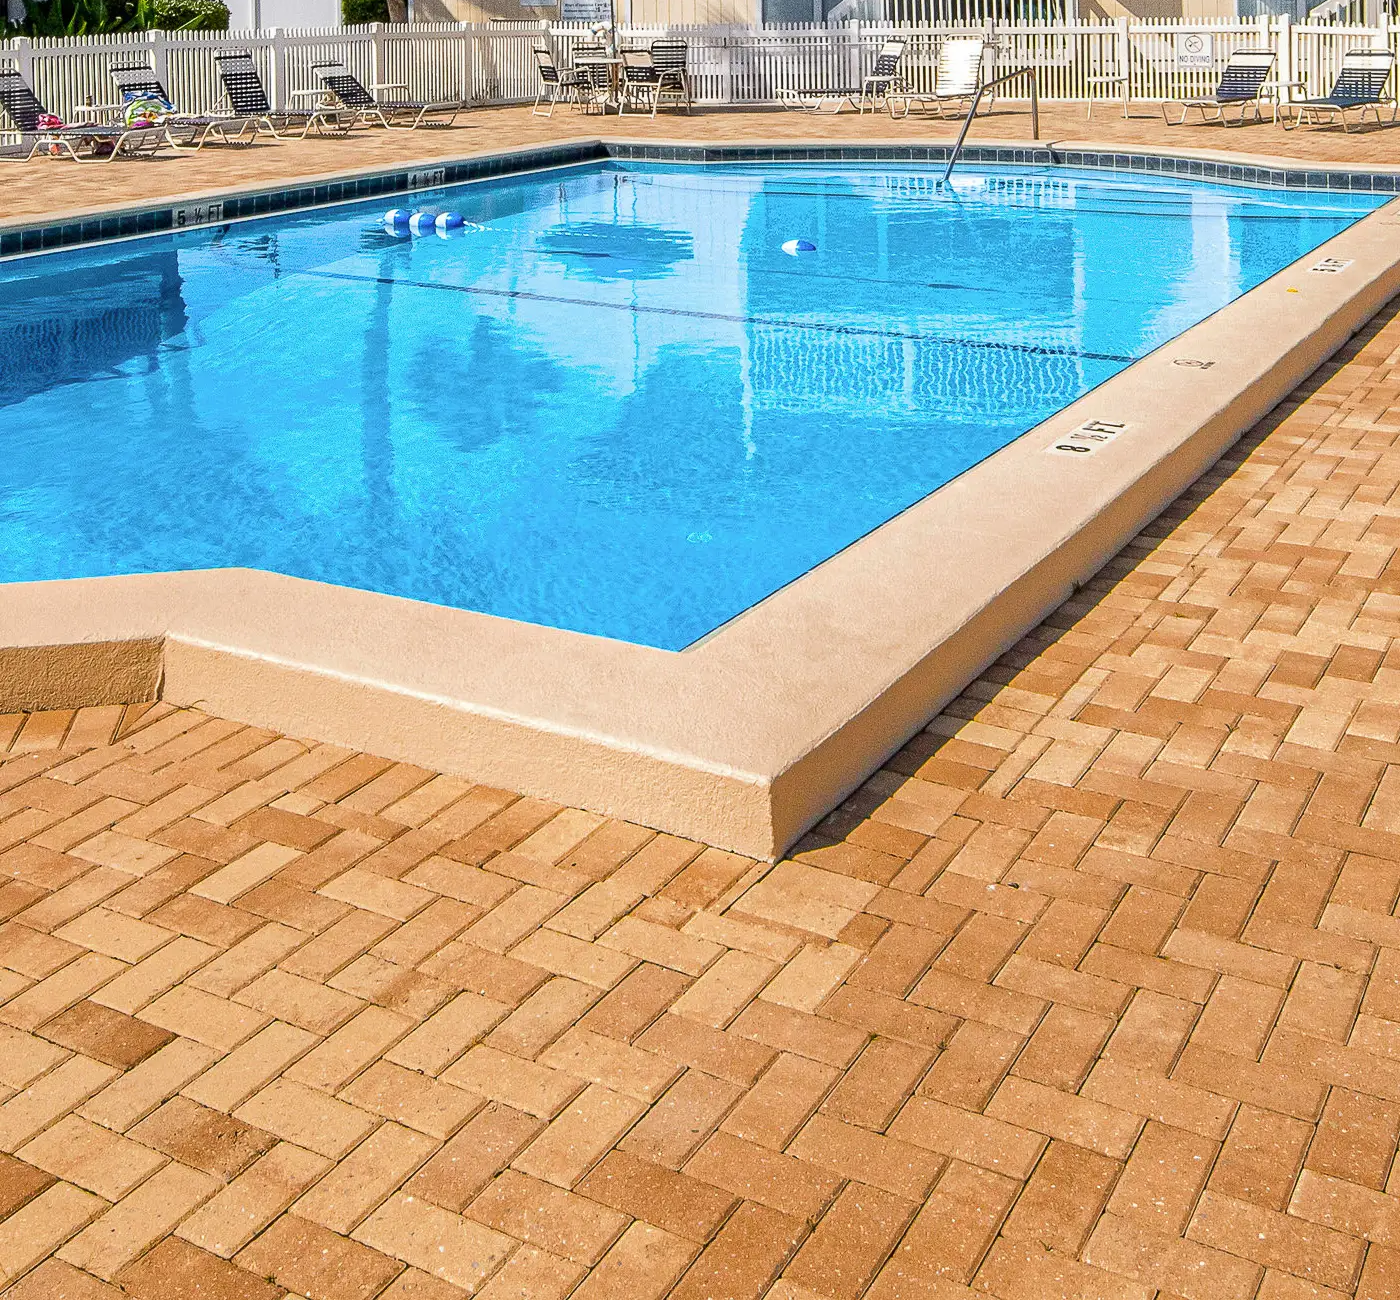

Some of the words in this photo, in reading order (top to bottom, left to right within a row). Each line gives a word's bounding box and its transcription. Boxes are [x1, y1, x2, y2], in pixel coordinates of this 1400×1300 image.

[1179, 55, 1188, 63] NO
[1190, 55, 1210, 63] DIVING
[433, 170, 445, 185] FT
[177, 209, 186, 225] 5
[208, 203, 222, 222] FT
[1055, 444, 1091, 453] 8
[1081, 420, 1126, 434] FT
